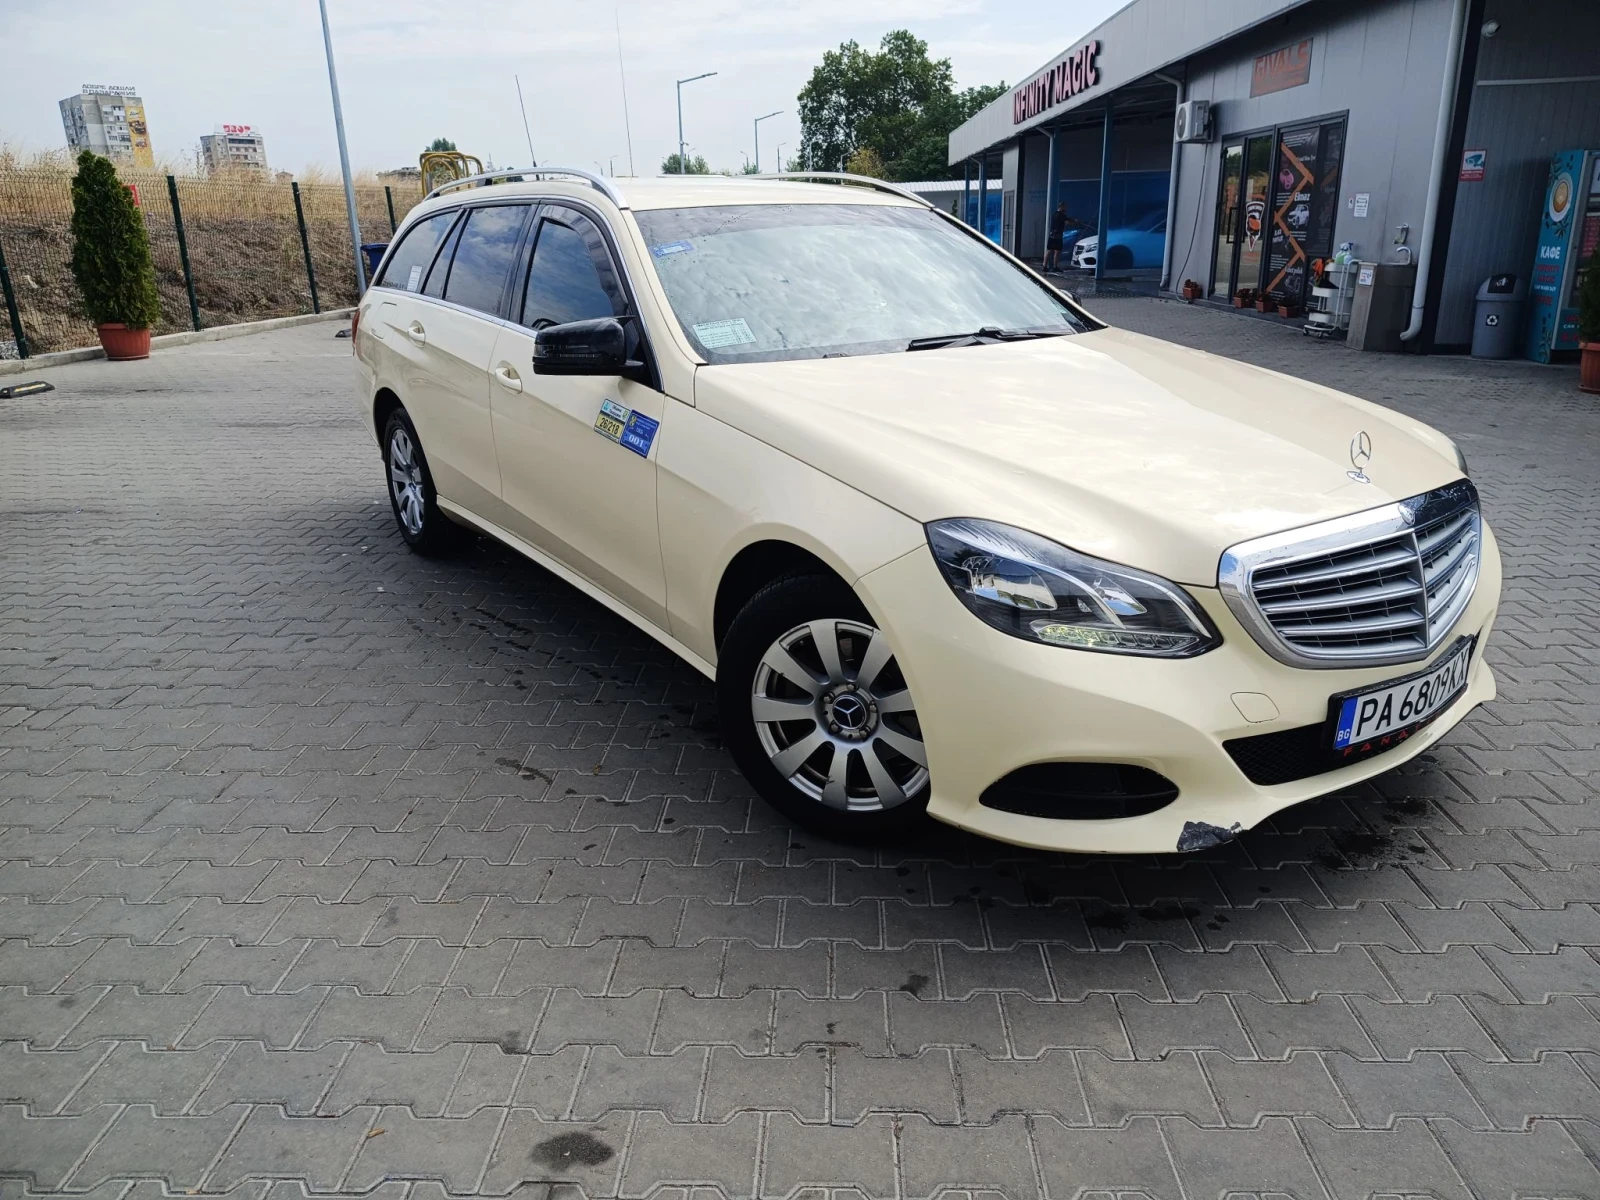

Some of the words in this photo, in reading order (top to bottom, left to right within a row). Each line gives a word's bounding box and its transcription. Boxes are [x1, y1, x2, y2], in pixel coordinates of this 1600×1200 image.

[1013, 69, 1054, 125] INFINITY
[1055, 40, 1101, 104] MAGIC
[1540, 246, 1561, 260] КАФЕ
[599, 417, 620, 435] 26/218
[628, 434, 644, 448] 001
[1337, 728, 1351, 742] BG
